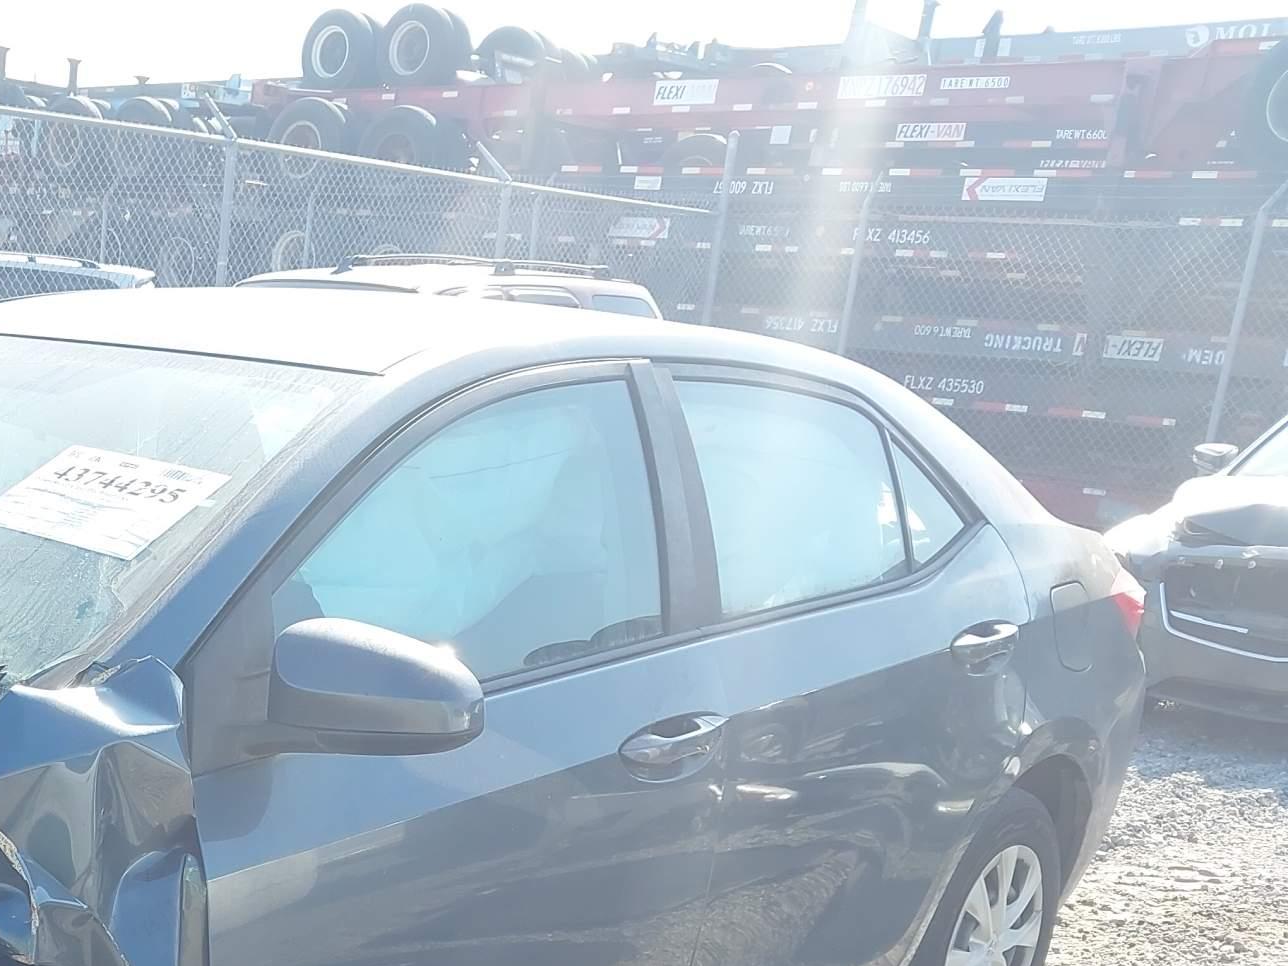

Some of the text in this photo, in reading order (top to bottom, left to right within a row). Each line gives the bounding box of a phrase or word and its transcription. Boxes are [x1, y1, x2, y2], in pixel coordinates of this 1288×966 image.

[984, 77, 1010, 88] 6500
[897, 123, 965, 139] FLEXI-VAN
[752, 181, 775, 195] FLXZ
[853, 228, 931, 244] FXZ 413456
[810, 318, 840, 333] FLXZ
[984, 333, 1063, 353] TRUCKING
[904, 374, 985, 395] FLXZ 435530
[54, 465, 187, 504] 43744295
